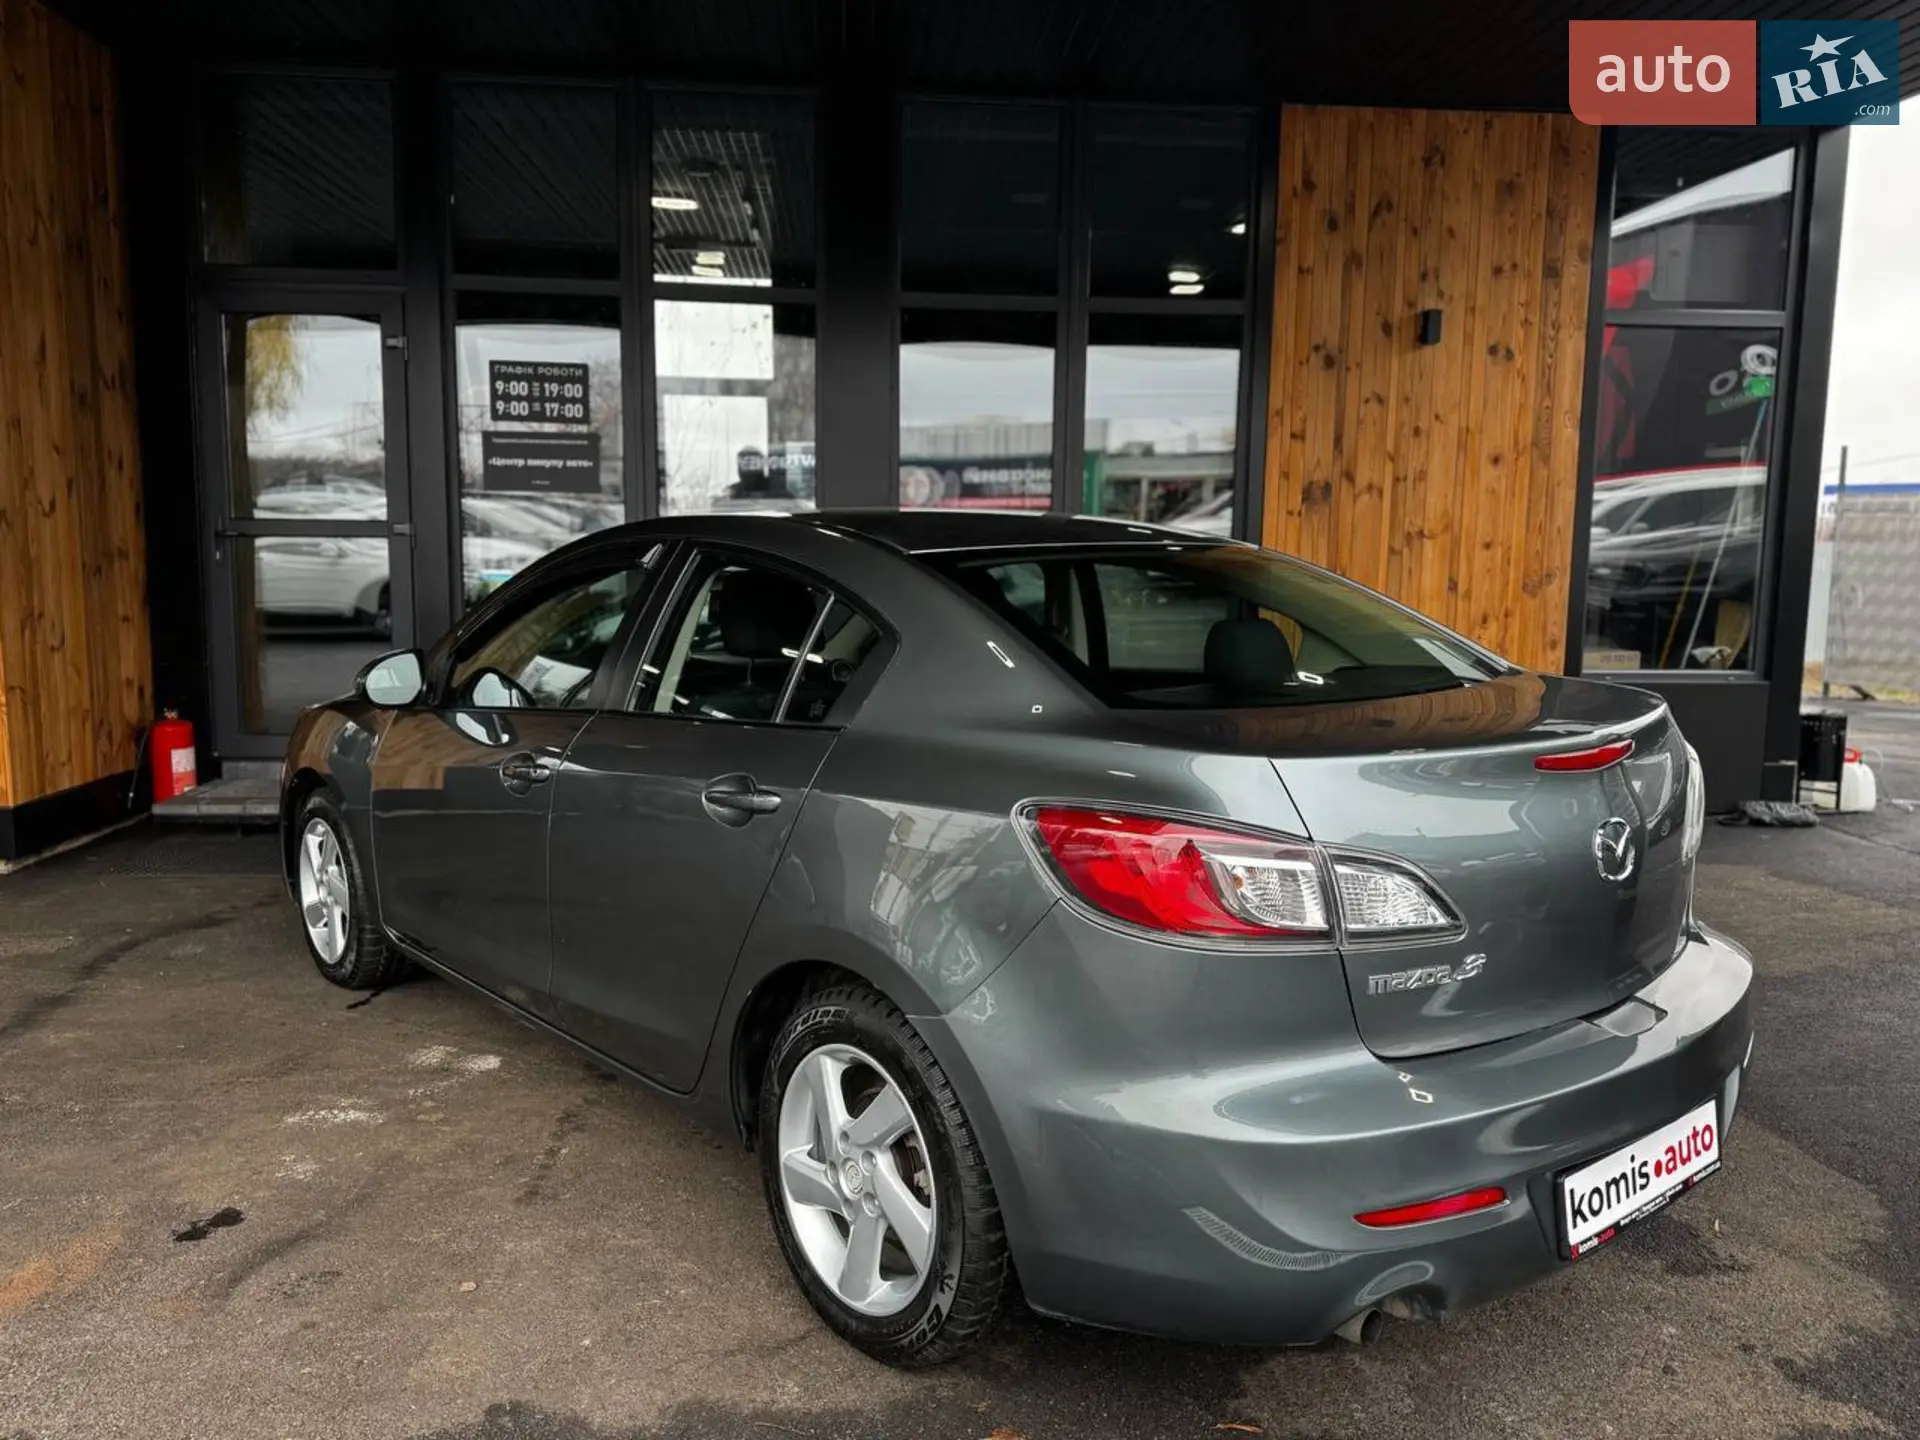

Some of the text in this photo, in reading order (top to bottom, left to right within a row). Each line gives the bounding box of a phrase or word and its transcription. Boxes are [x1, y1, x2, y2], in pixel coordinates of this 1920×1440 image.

[494, 365, 584, 378] ГРАФІК РОБОТИ
[495, 380, 529, 397] 9:00
[543, 382, 583, 398] 19:00
[496, 400, 529, 416] 9:00
[544, 402, 584, 418] 17:00
